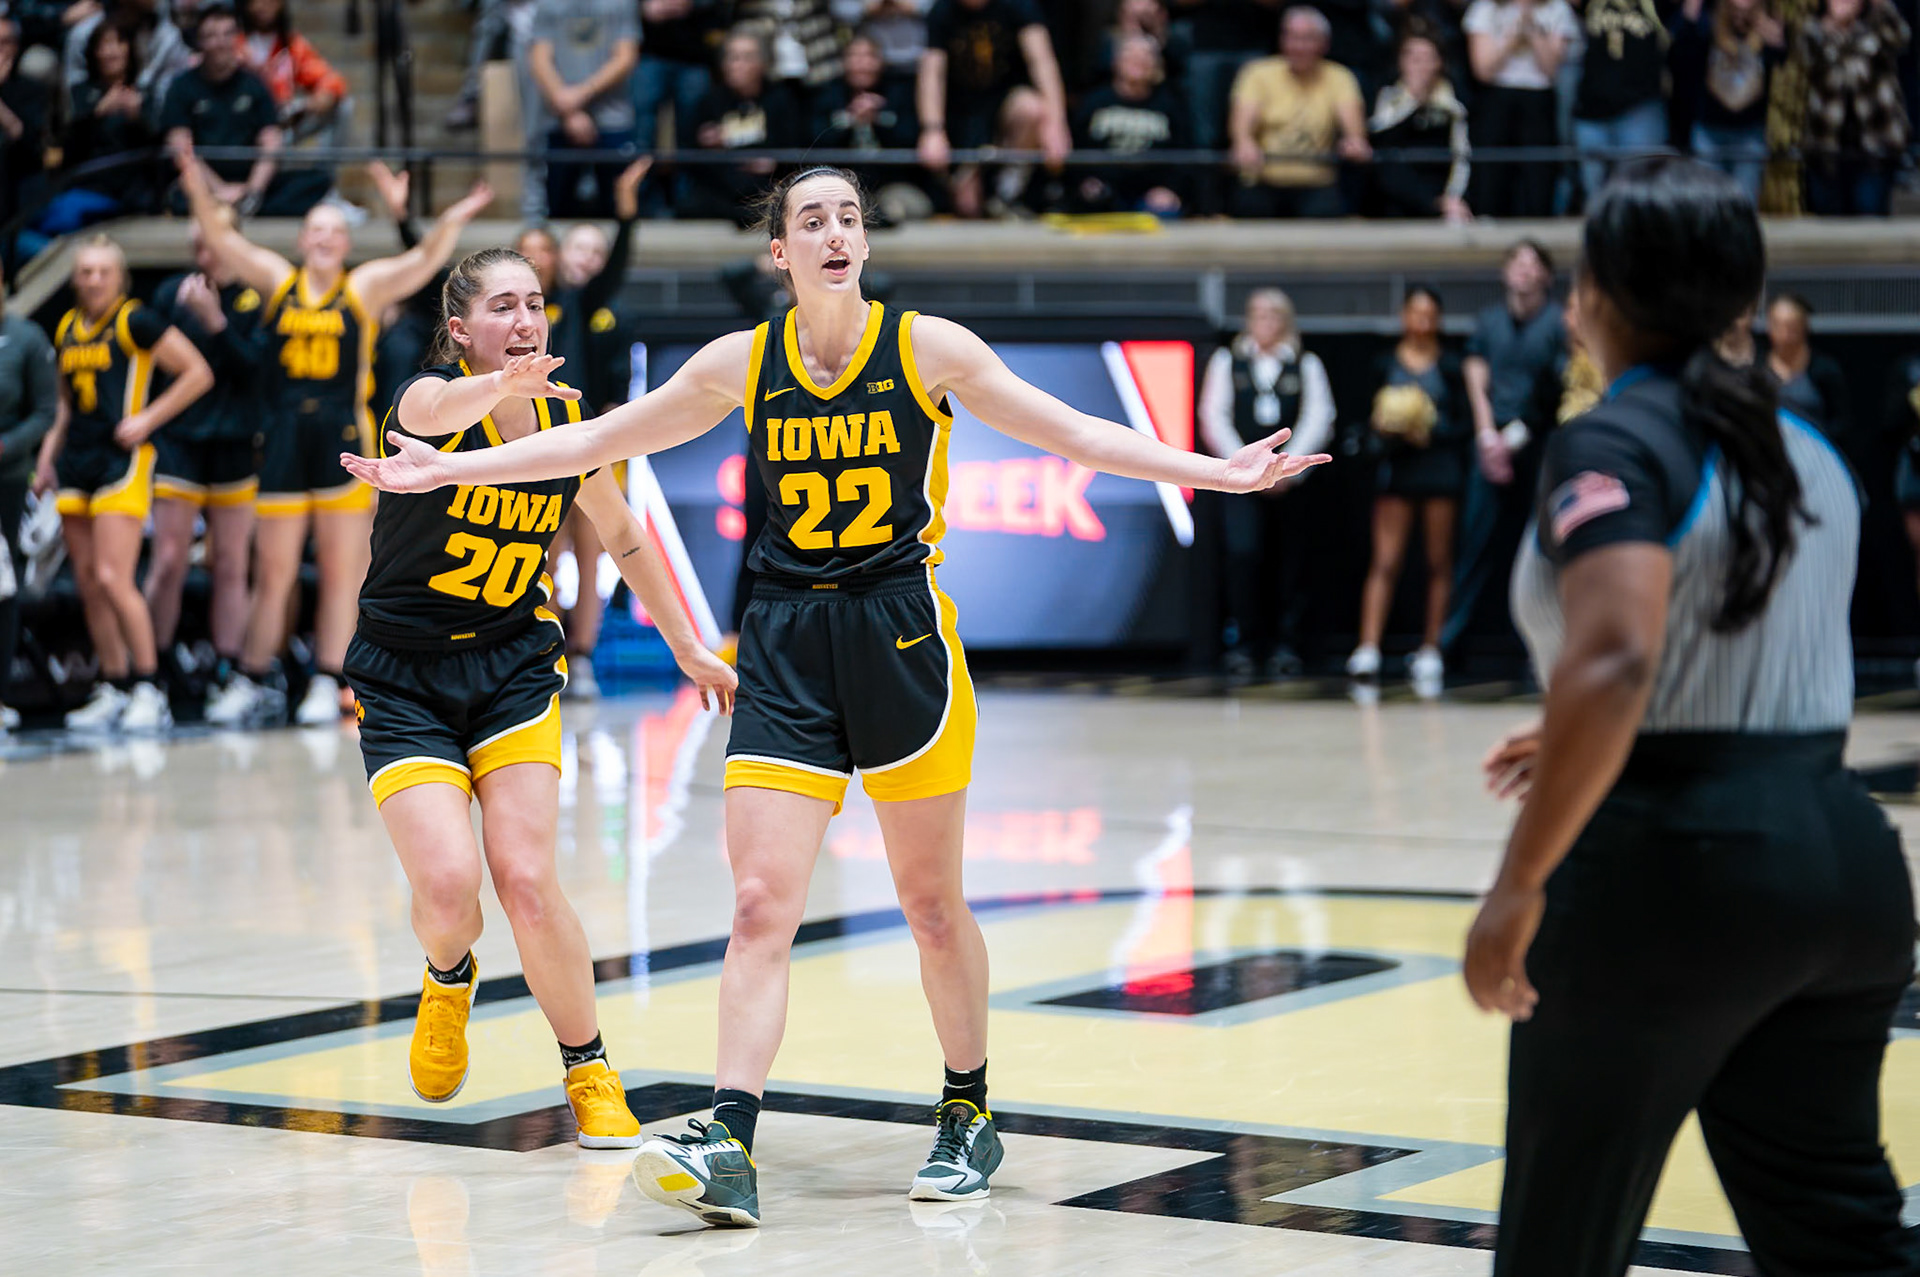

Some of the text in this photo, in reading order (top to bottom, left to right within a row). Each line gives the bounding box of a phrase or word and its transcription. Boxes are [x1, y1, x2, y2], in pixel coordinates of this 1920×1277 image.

[766, 410, 901, 462] IOWA
[446, 484, 563, 533] IOWA
[778, 466, 893, 550] 22
[943, 455, 1107, 542] EEK
[428, 531, 544, 608] 20
